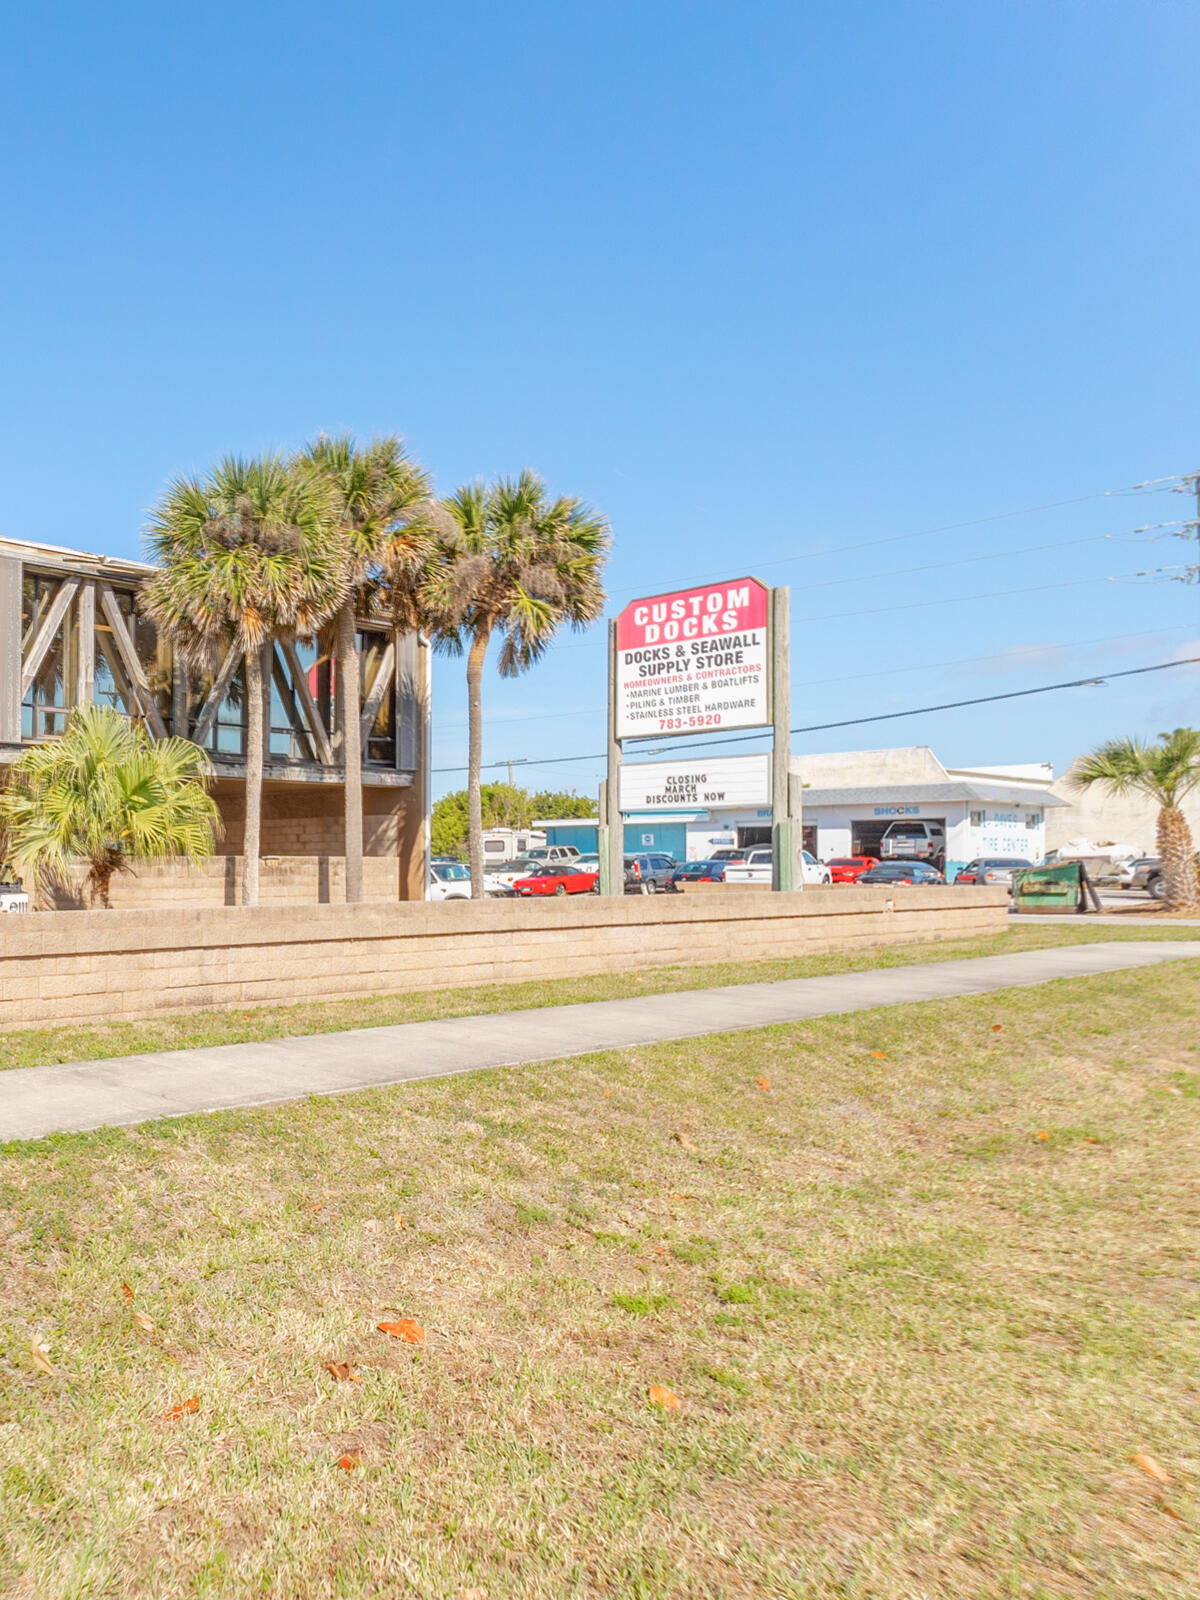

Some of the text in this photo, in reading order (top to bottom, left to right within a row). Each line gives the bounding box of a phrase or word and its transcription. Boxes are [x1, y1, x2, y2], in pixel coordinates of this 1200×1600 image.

[634, 586, 749, 626] CUSTOM
[645, 610, 738, 644] DOCKS
[625, 633, 760, 665] DOCKS & SEAWALL
[639, 651, 744, 677] SUPPLY STORE
[623, 674, 683, 689] HOMEOWNERS
[695, 663, 762, 680] CONTRACTORS
[630, 675, 760, 699] MARINE LUMBER & BOATLIFTS
[630, 694, 700, 709] PILING & TIMBER
[630, 698, 756, 720] STAINLESS STEEL HARDWARE
[659, 713, 722, 730] 783-5920
[665, 784, 697, 794] MARCH
[666, 774, 707, 785] CLOSING
[646, 792, 725, 804] DISCOUNTS NOW
[874, 806, 920, 816] SHOCKS
